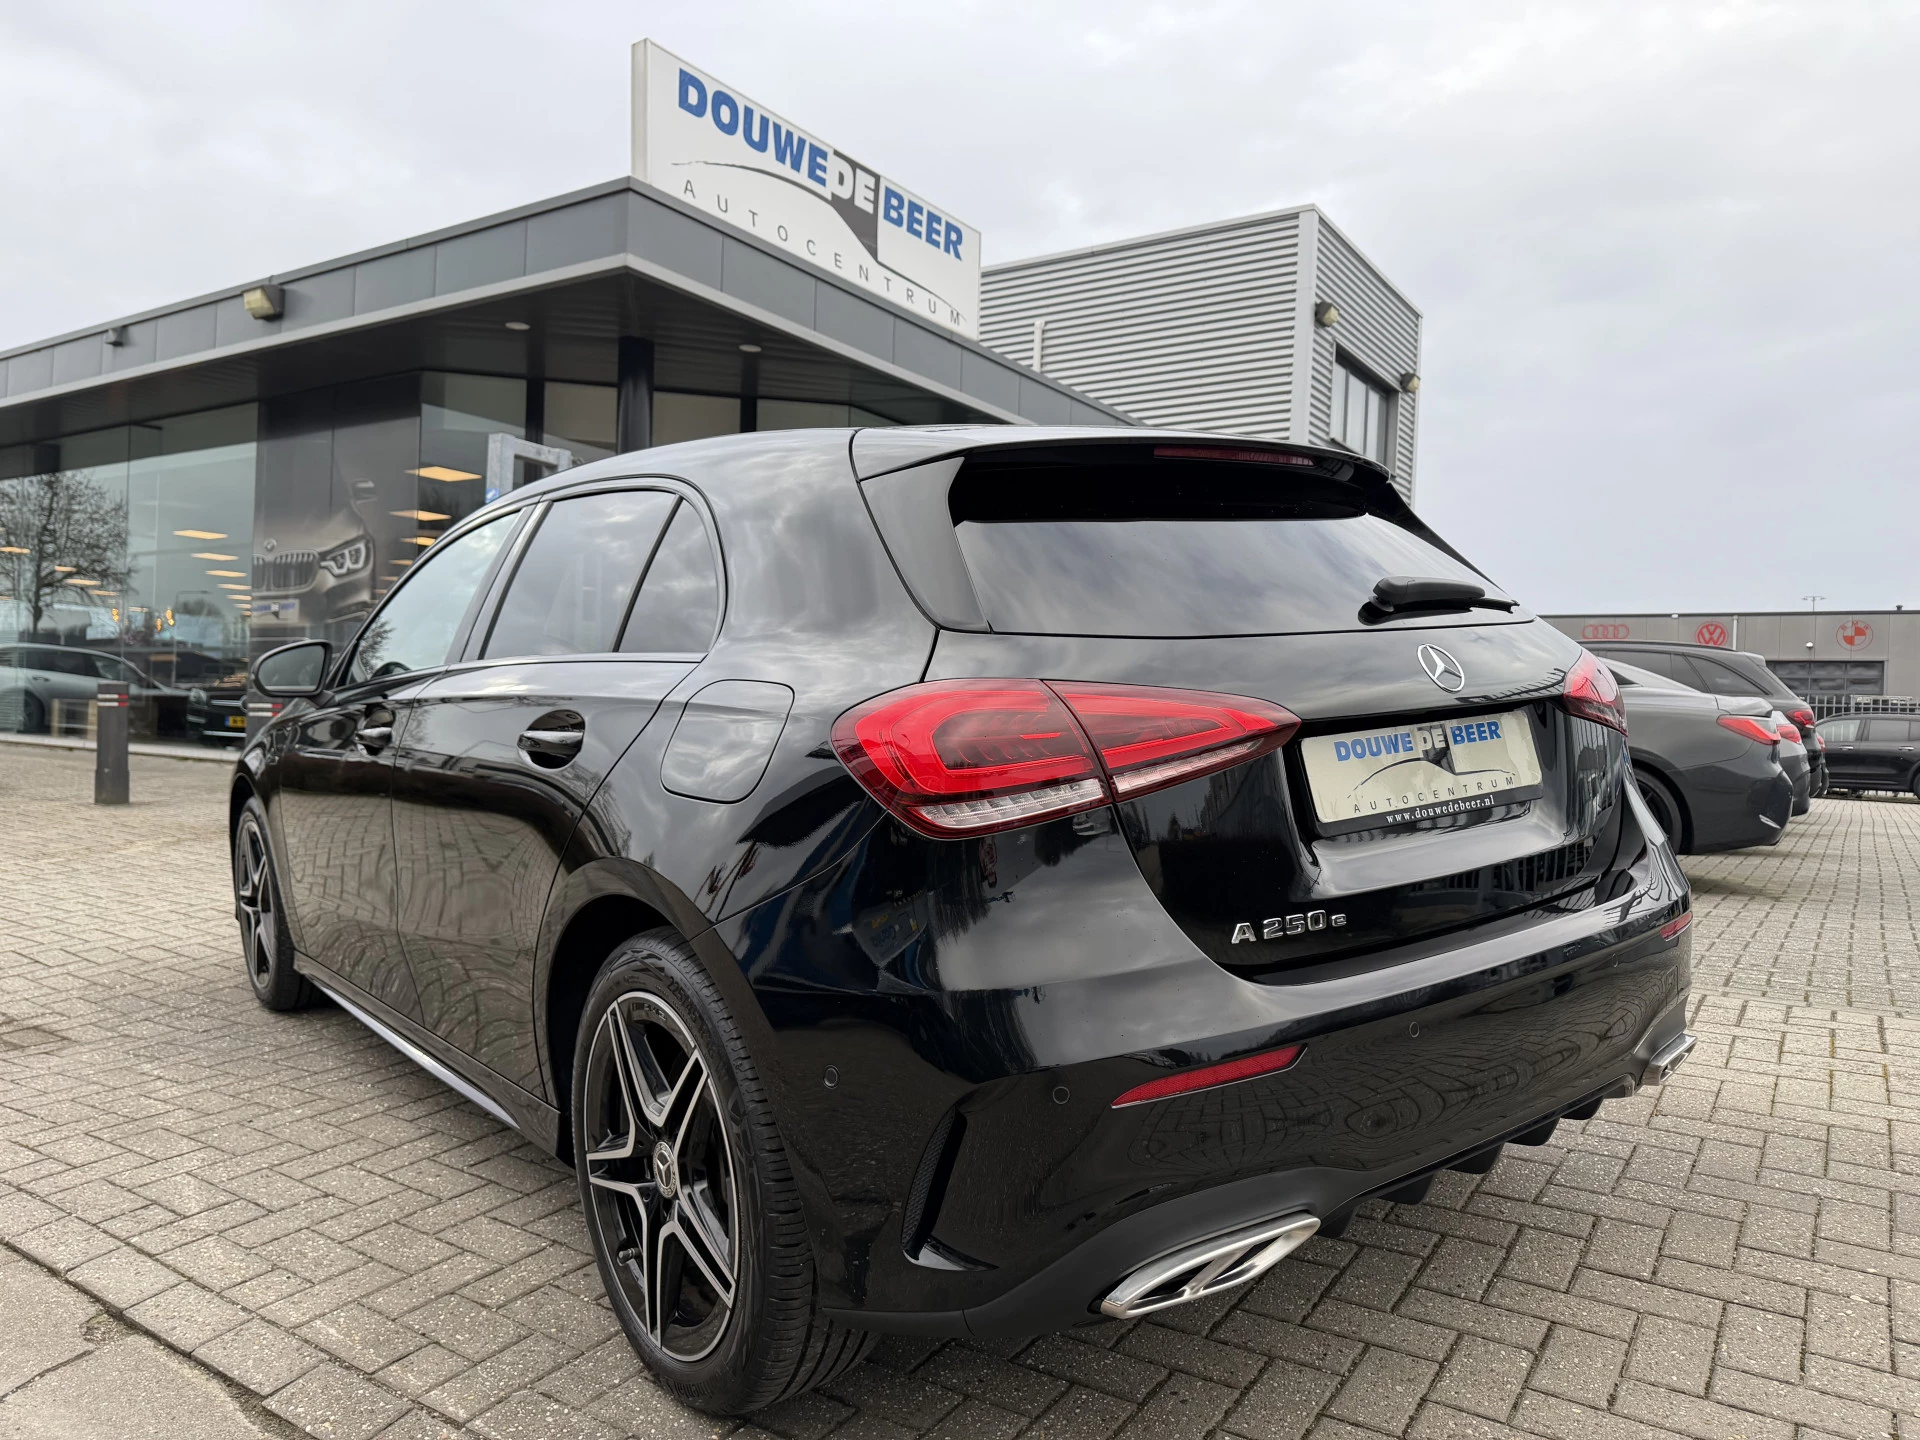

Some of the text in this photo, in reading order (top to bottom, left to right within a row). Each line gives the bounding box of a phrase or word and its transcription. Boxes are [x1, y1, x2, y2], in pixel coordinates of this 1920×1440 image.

[679, 68, 963, 261] DOUWE DE BEER
[683, 179, 961, 327] AUTOCENTRUM
[1333, 720, 1502, 762] DOUWE DE BEER
[1353, 776, 1515, 814] AUTOCENTRUM
[1385, 794, 1496, 824] www.douwedebeer.nl
